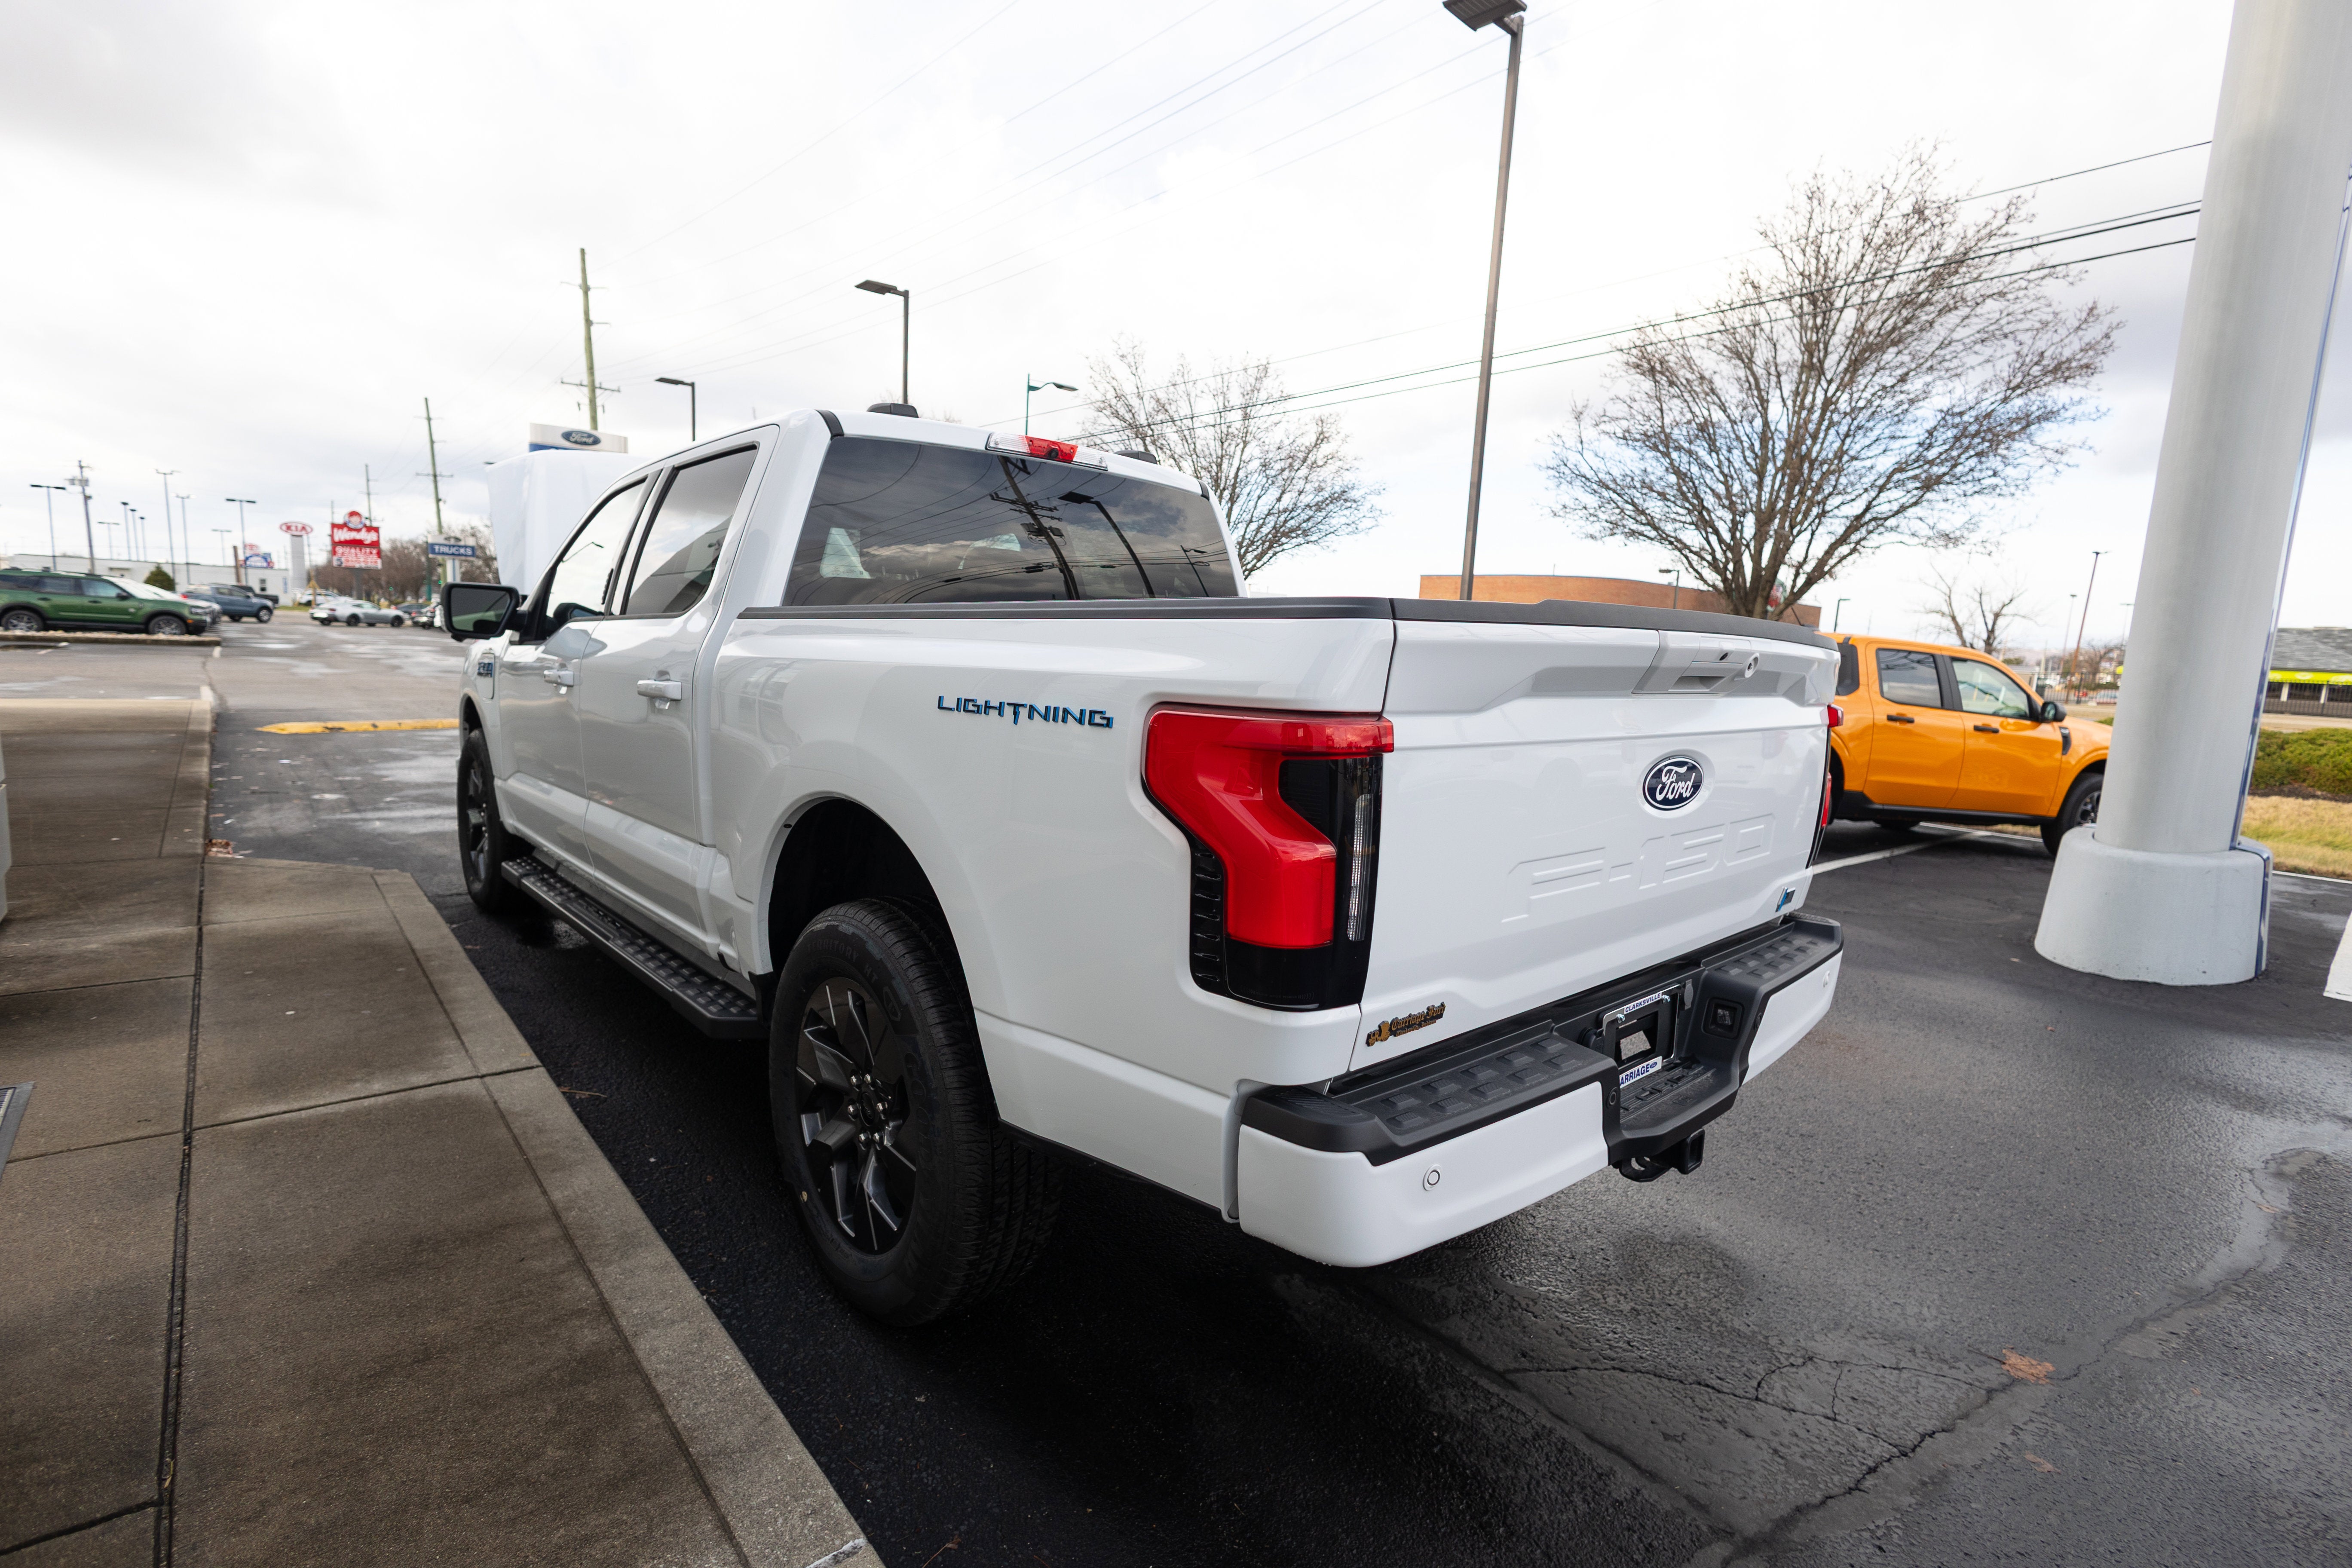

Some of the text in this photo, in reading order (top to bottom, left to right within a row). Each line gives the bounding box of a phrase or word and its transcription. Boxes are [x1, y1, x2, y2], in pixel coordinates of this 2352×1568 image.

[569, 432, 594, 444] Ford
[333, 527, 378, 544] Wendy's
[433, 545, 472, 556] TRUCKS
[937, 695, 1114, 728] LIGHTNING
[1656, 766, 1695, 801] Ford
[1501, 812, 1776, 922] F-150
[807, 939, 859, 962] TERRITORY
[1625, 992, 1661, 1013] CLARKSVILLE
[1390, 1011, 1425, 1030] Carriage
[1619, 1063, 1650, 1086] ARRIAGE
